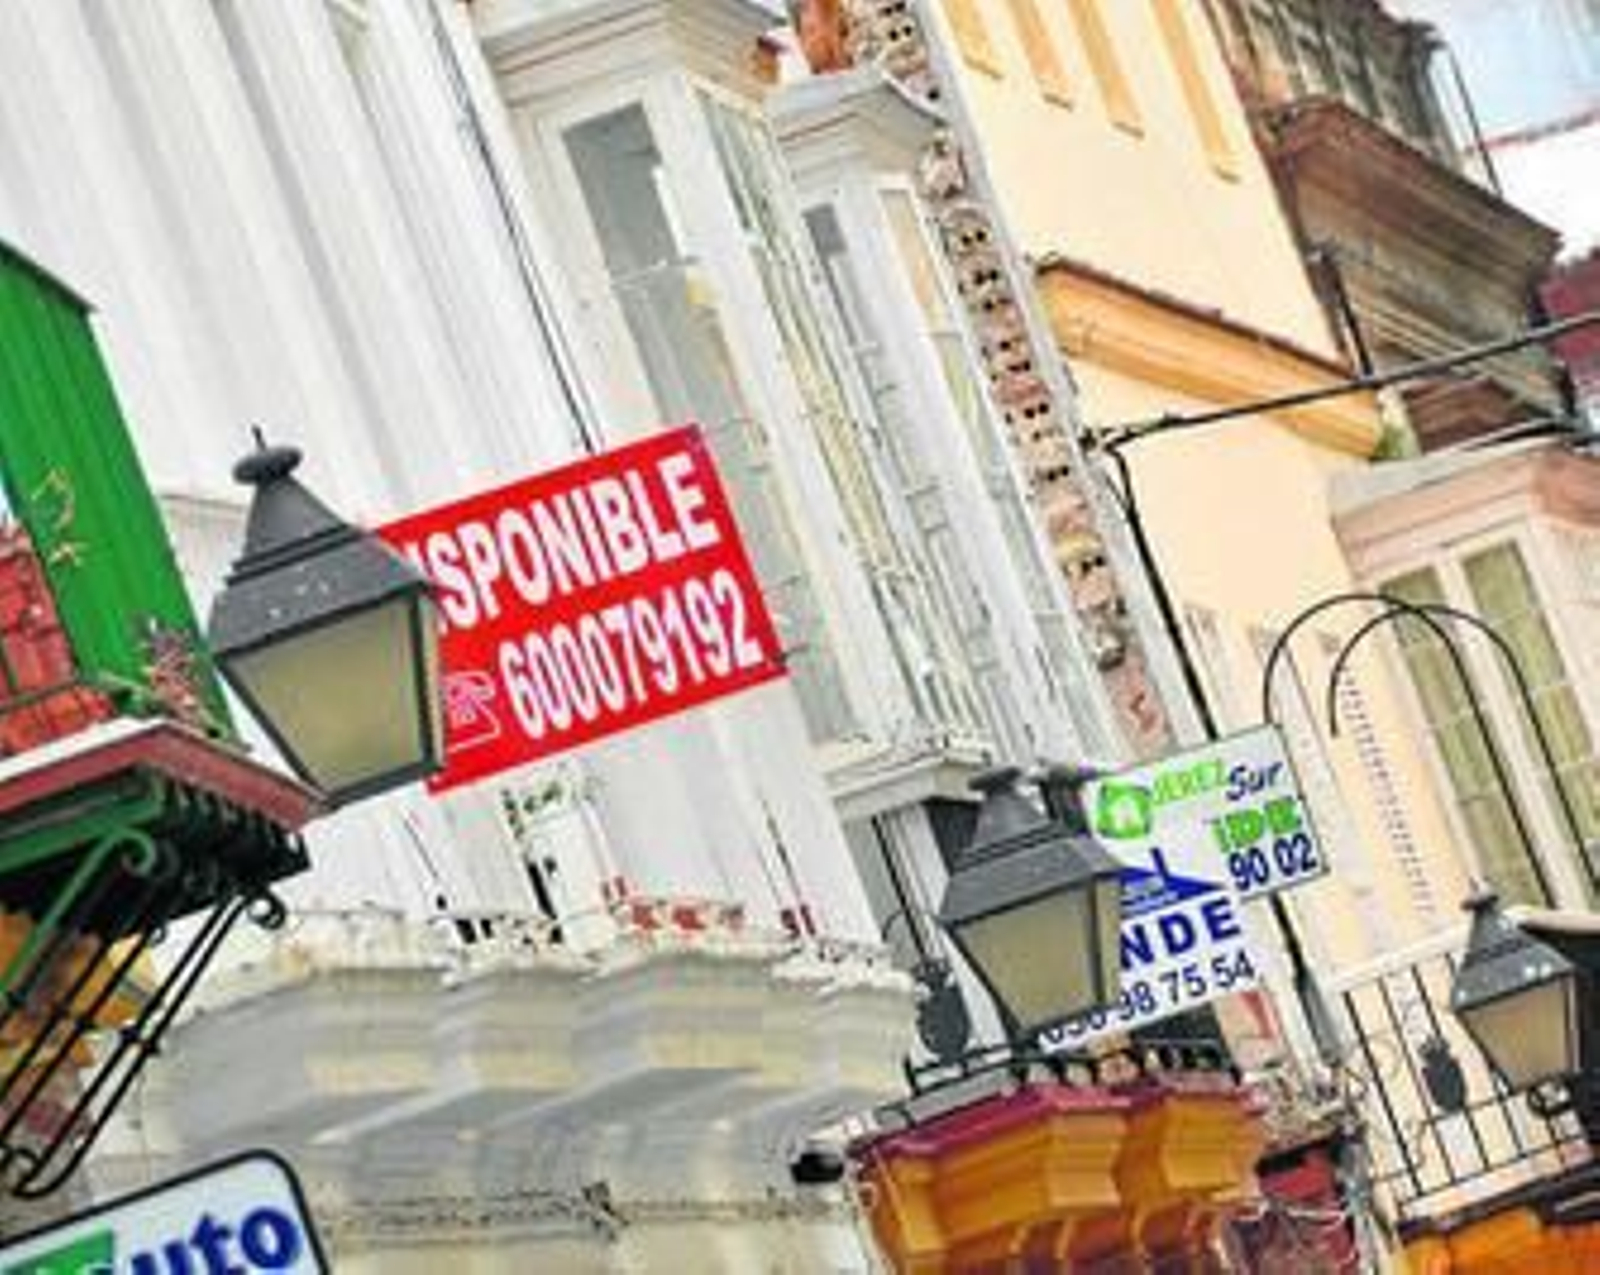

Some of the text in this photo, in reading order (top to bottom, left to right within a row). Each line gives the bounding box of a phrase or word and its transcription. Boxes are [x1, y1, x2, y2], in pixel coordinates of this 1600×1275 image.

[406, 452, 720, 635] ISPONIBLE
[499, 568, 763, 740] 600079192
[1228, 833, 1317, 891] 90 02
[1159, 963, 1207, 1005] 75
[1211, 949, 1256, 989] 54
